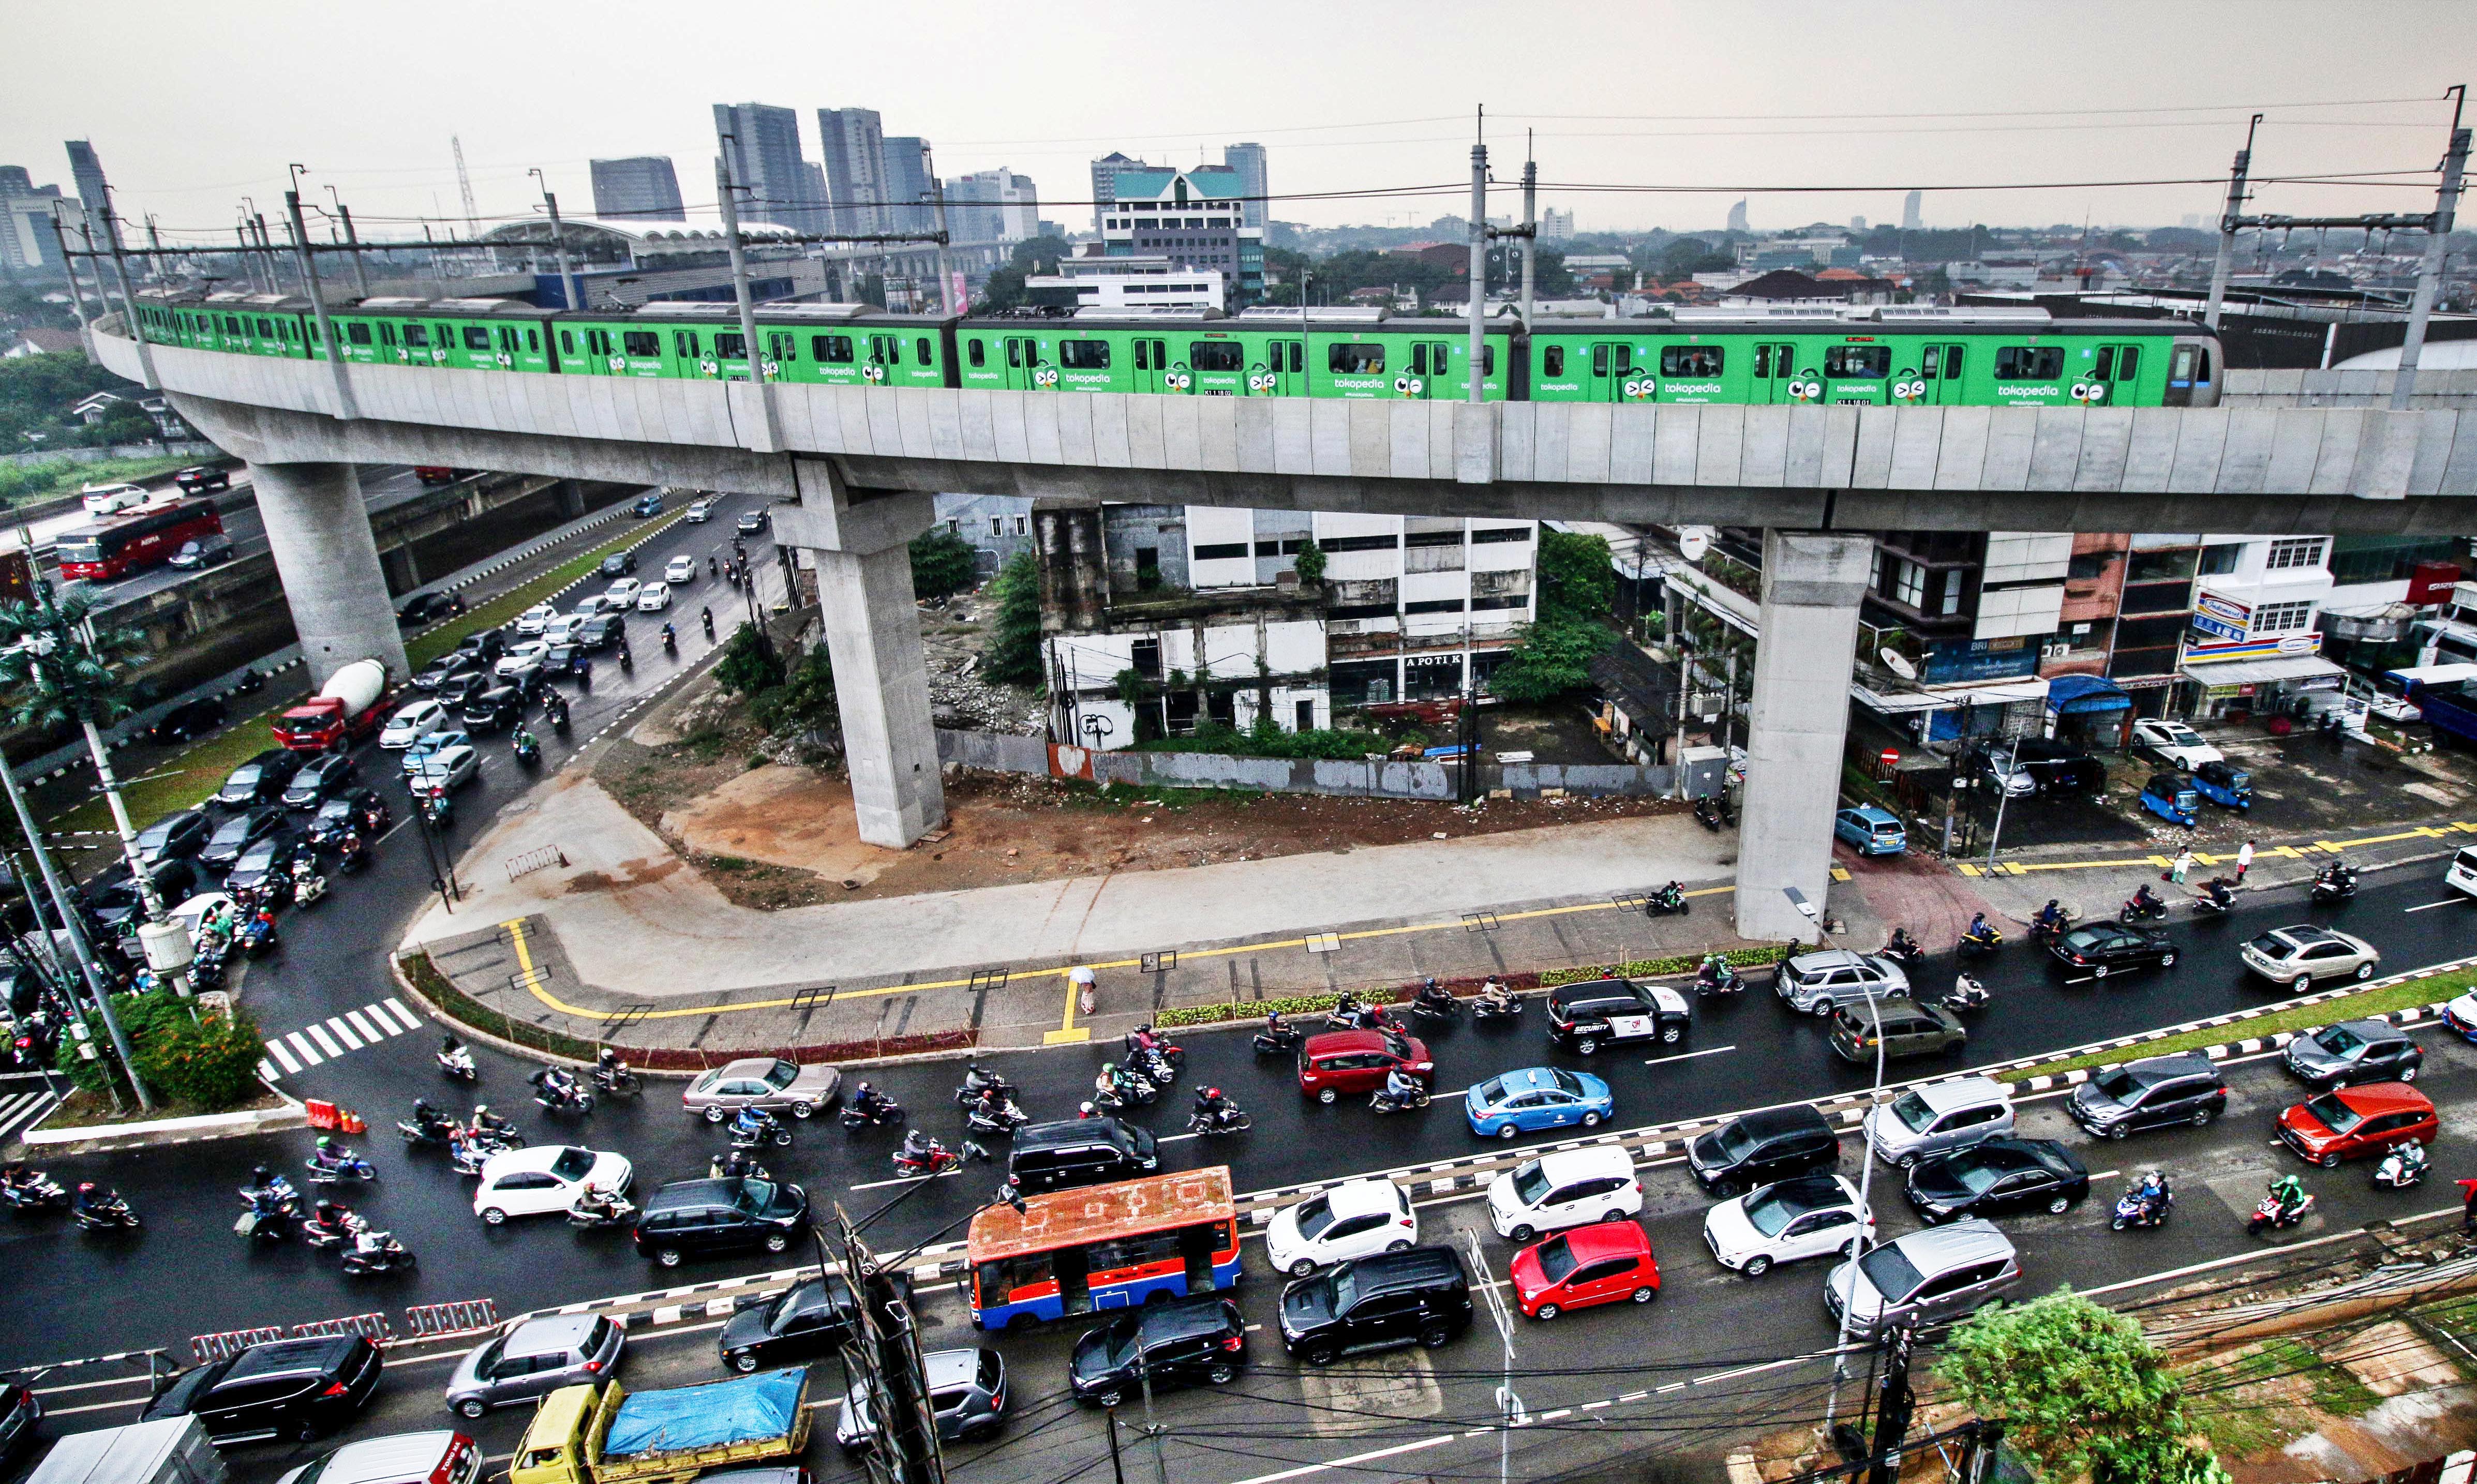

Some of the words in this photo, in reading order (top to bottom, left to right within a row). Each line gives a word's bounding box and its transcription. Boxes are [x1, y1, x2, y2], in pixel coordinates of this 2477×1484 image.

[819, 367, 855, 377] tokopedia
[1066, 373, 1110, 384] tokopedia
[1334, 378, 1384, 390] tokopedia
[1540, 383, 1578, 392] tokopedia
[1665, 383, 1721, 395] tokopedia
[1837, 385, 1877, 394] tokopedia
[1998, 385, 2058, 398] tokopedia
[1971, 641, 1987, 651] BRI
[1574, 1024, 1609, 1032] SECURITY
